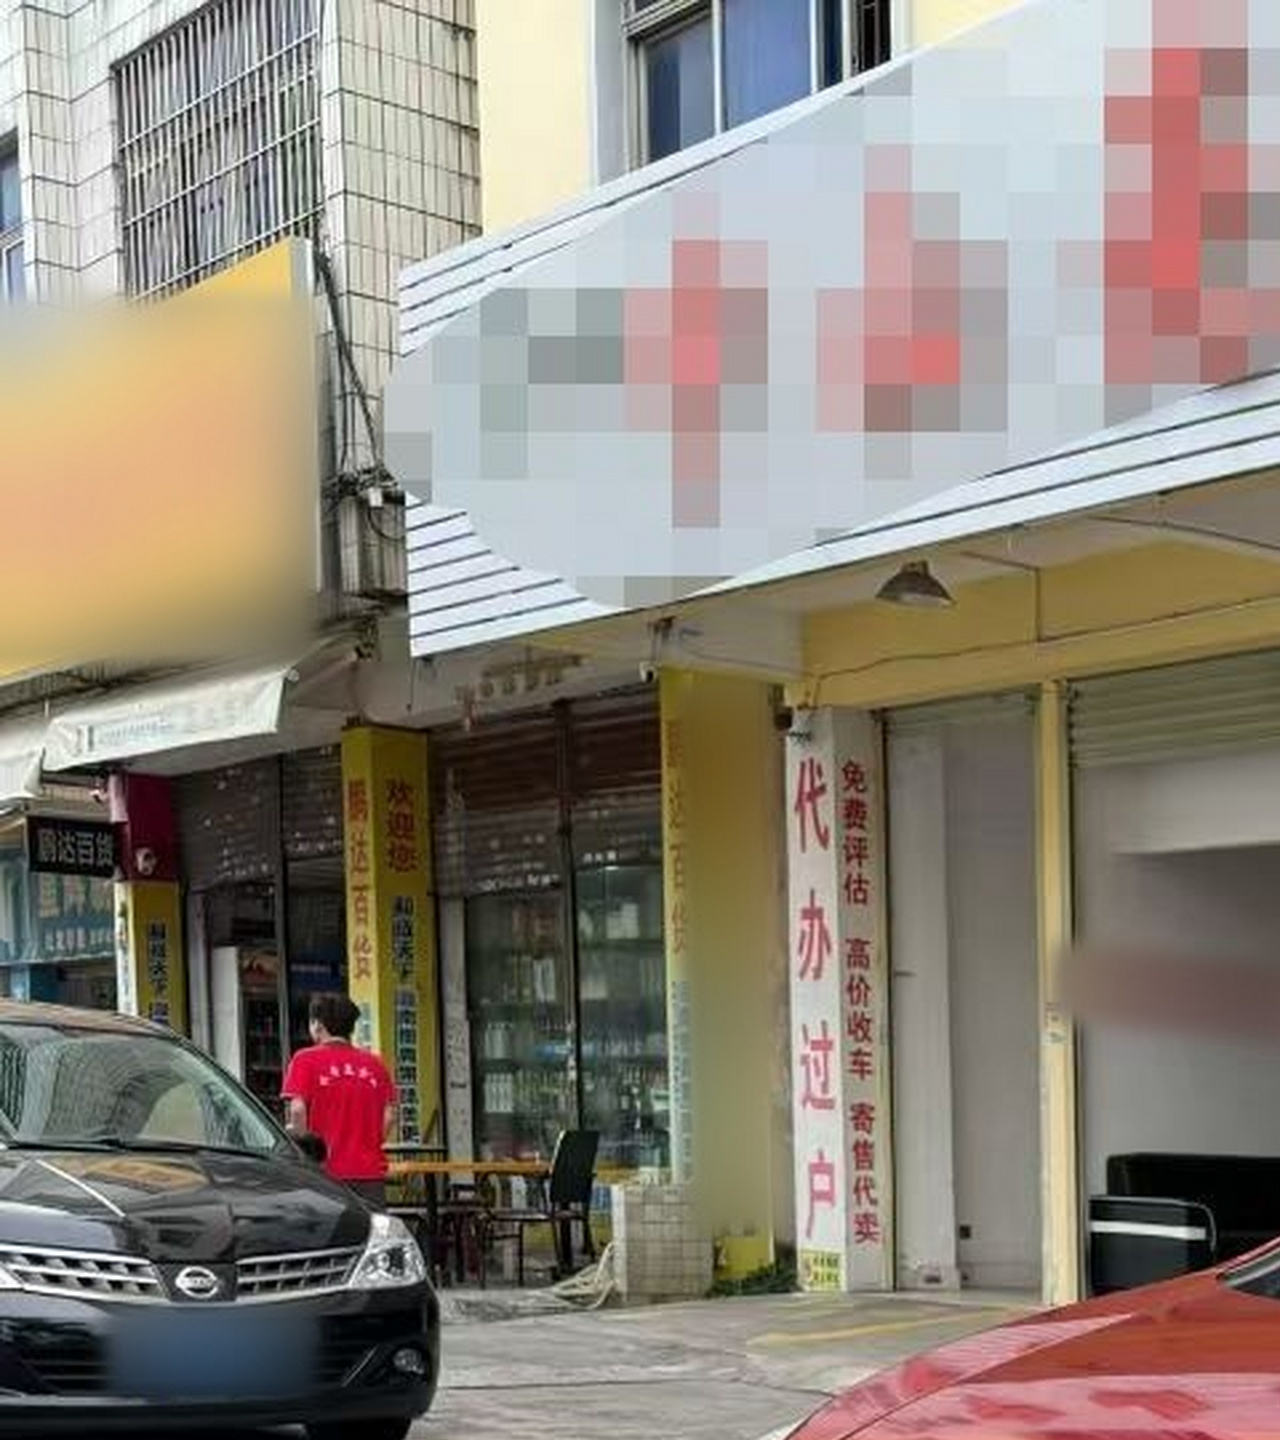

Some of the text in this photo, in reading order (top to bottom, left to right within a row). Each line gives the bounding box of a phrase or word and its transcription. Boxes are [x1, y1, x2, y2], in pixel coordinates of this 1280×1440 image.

[385, 778, 418, 873] 欢迎您
[794, 757, 836, 1239] 代办过户
[842, 759, 880, 1244] 免费评估 高价收车 寄售代卖
